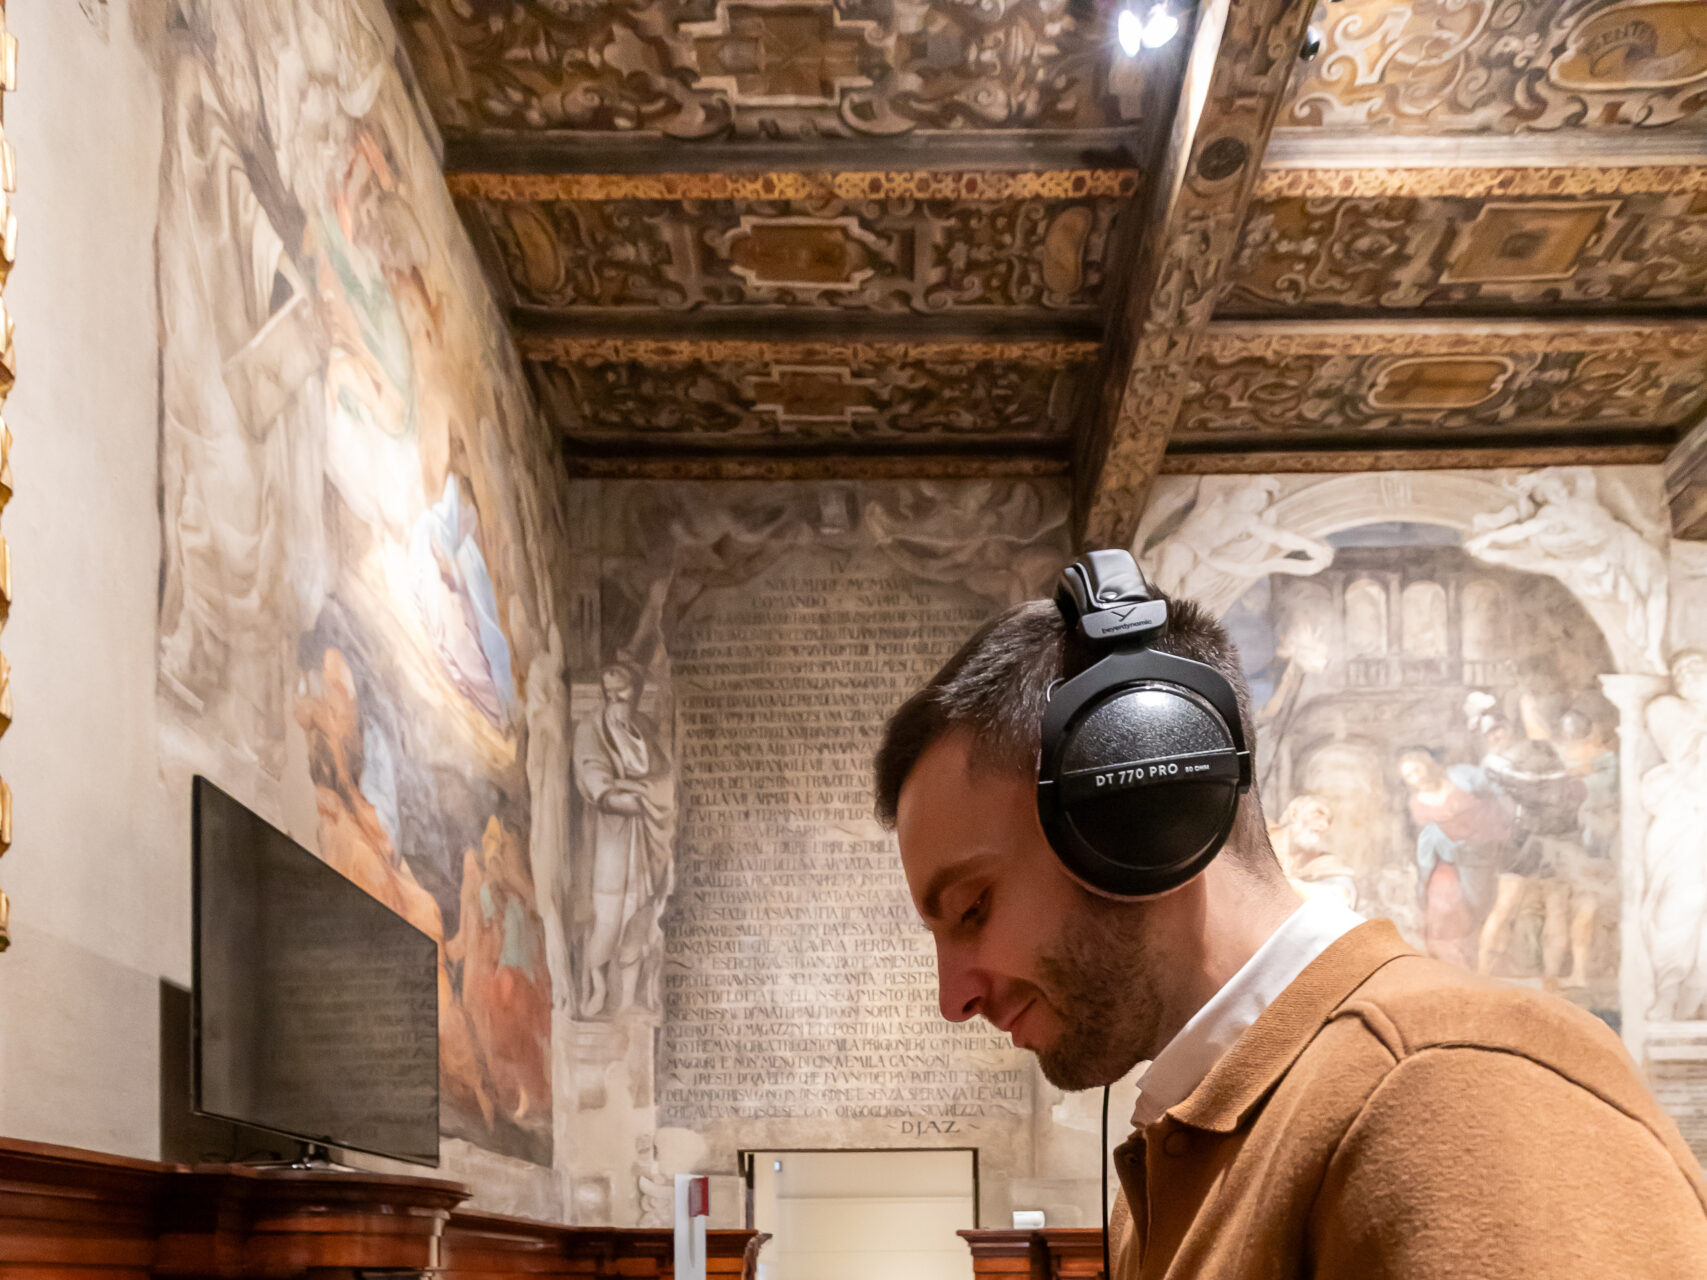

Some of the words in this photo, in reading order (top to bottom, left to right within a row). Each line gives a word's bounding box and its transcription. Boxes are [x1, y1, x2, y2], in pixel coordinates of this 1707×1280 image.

[1101, 619, 1153, 634] beyerdynamic
[1095, 773, 1113, 787] DT
[1119, 767, 1145, 785] 770
[1149, 762, 1178, 779] PRO
